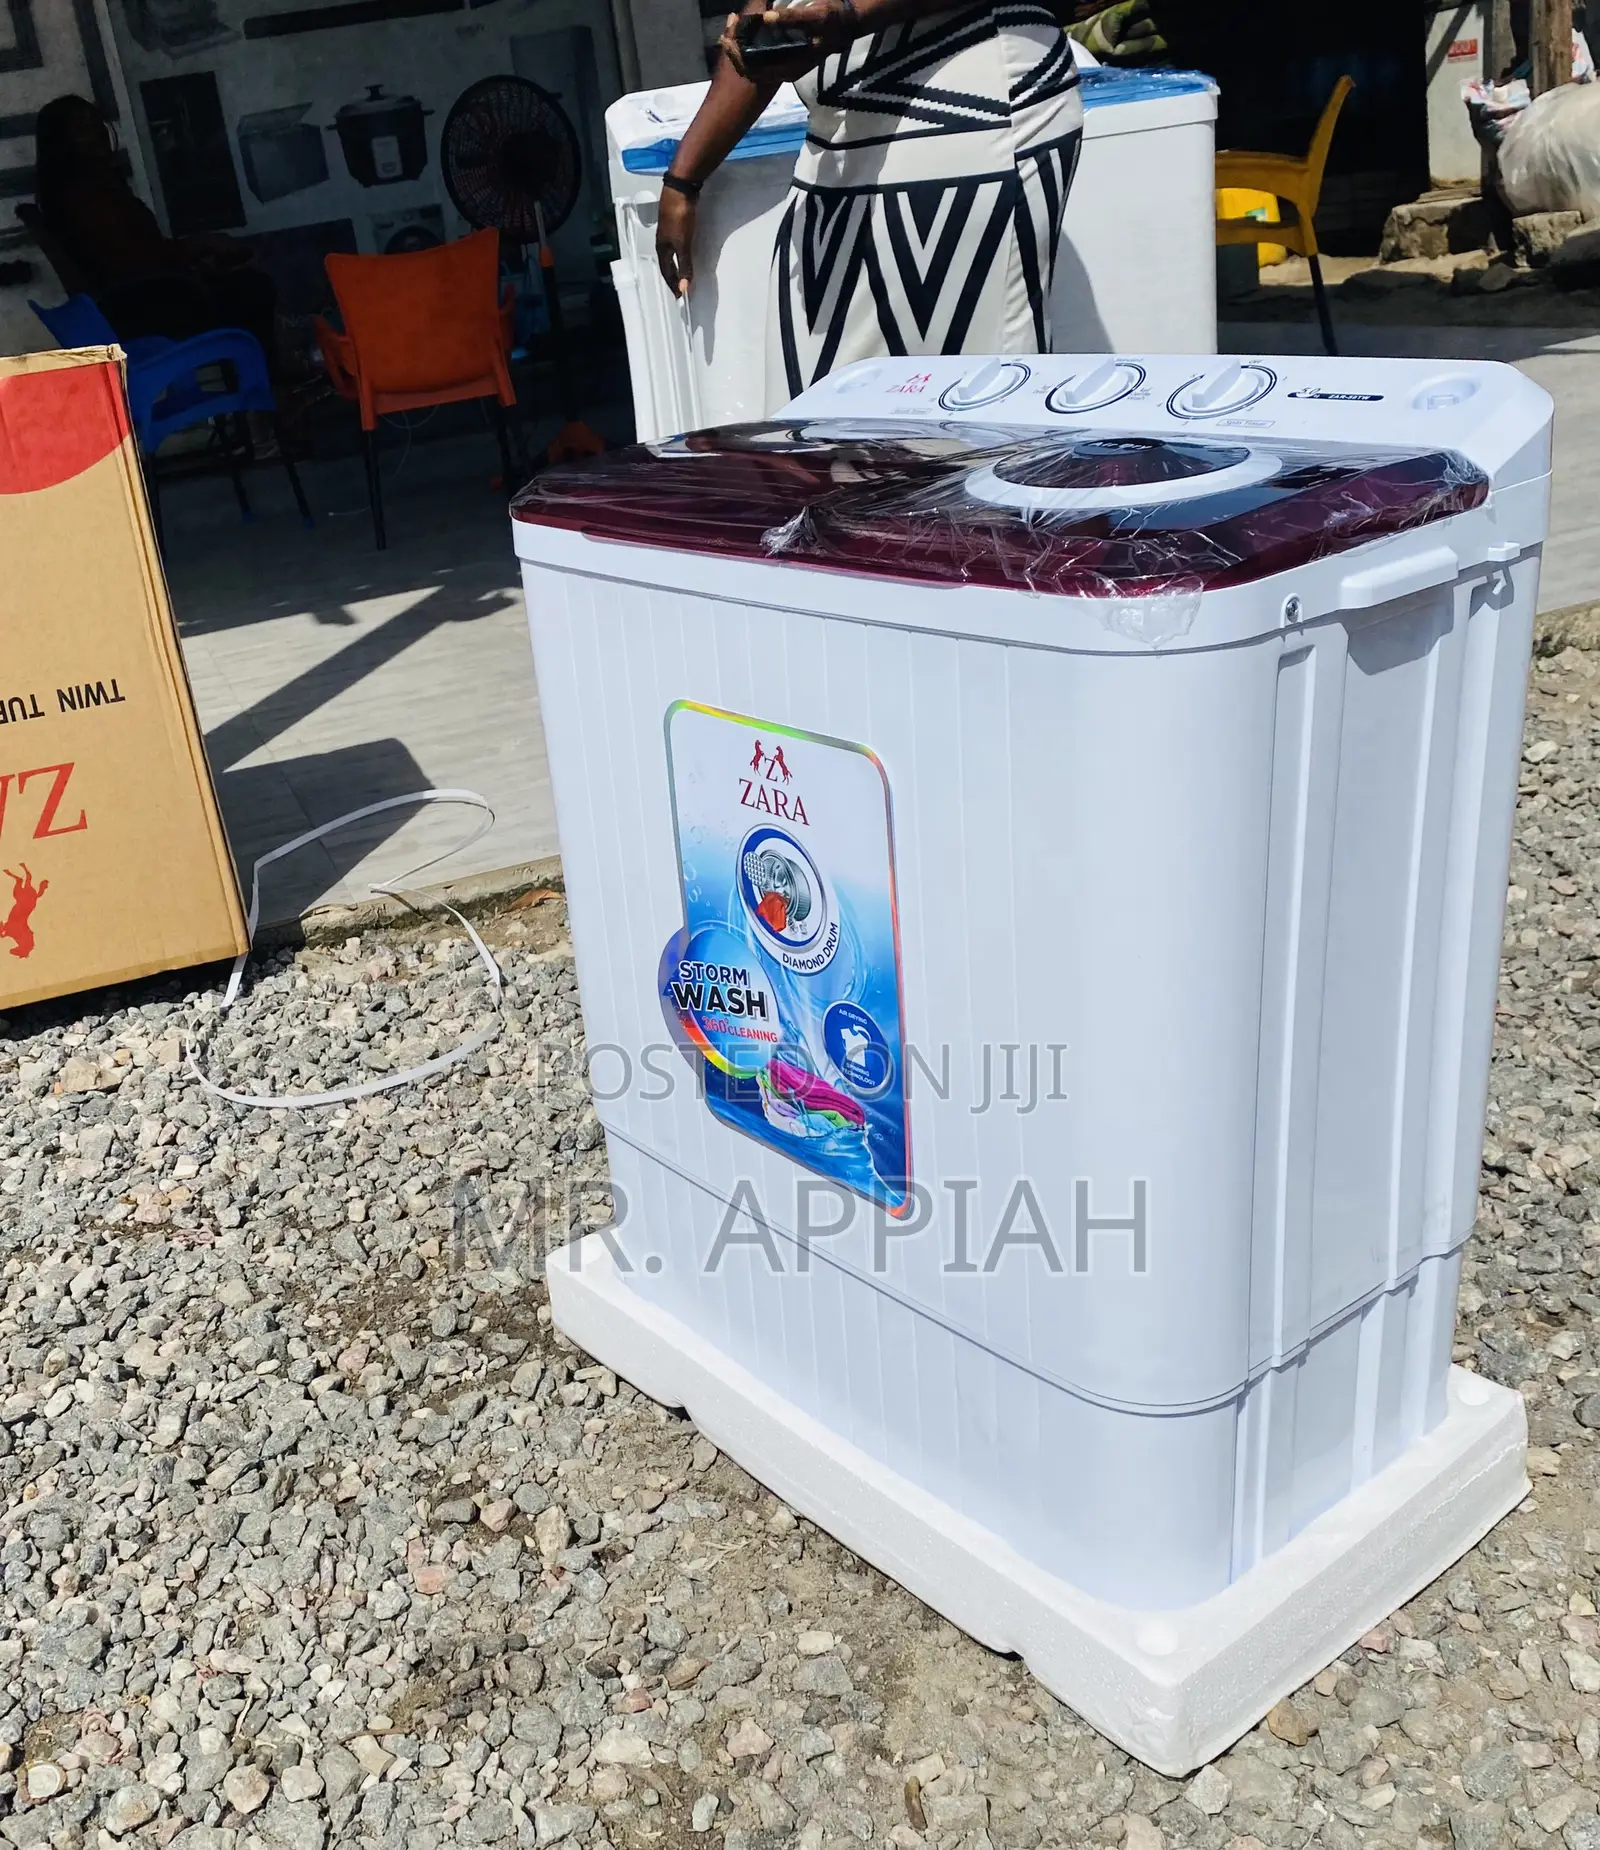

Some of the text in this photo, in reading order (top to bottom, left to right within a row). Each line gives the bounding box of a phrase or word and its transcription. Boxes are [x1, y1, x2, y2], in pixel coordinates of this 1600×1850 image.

[56, 678, 126, 713] TWIN
[738, 778, 810, 826] ZARA
[782, 922, 838, 970] DIAMOND DRUM
[680, 961, 749, 986] STORM
[672, 982, 768, 1018] WASH
